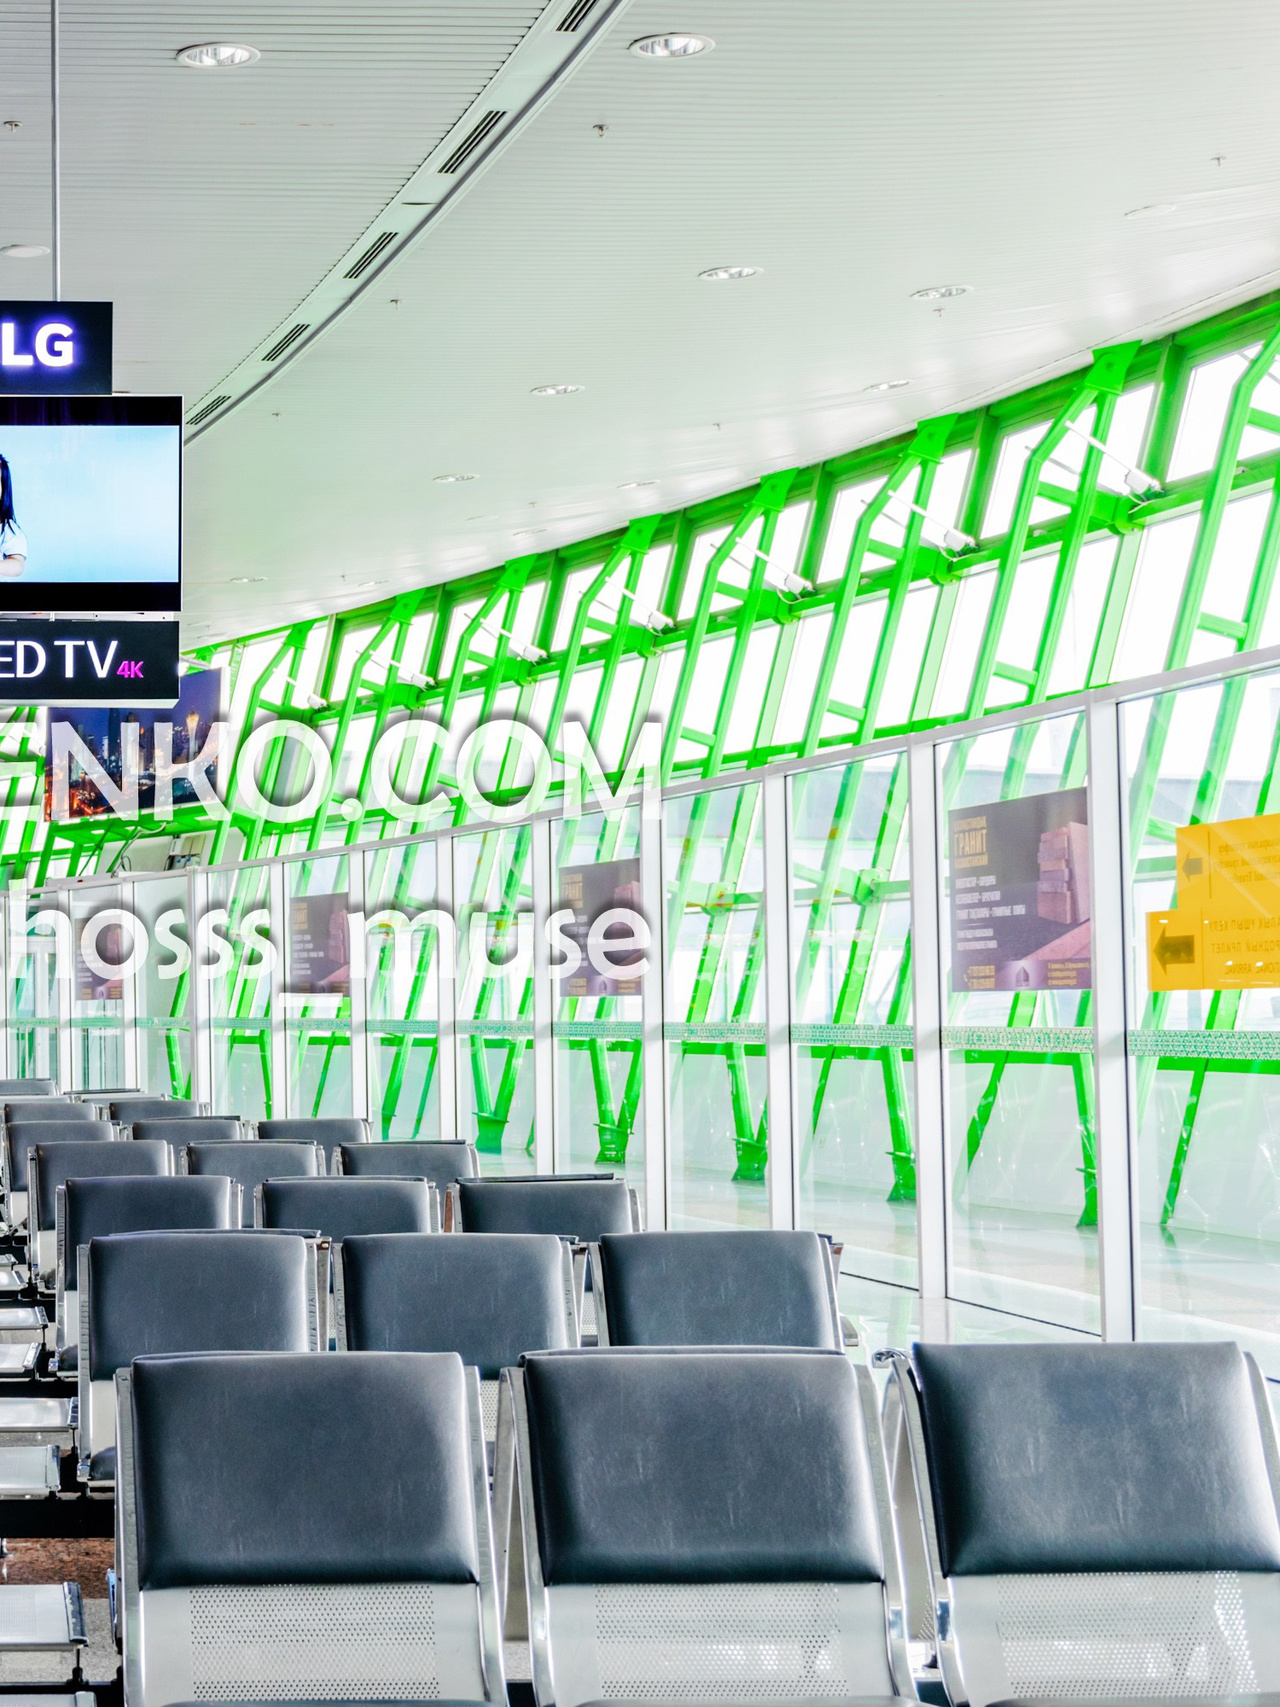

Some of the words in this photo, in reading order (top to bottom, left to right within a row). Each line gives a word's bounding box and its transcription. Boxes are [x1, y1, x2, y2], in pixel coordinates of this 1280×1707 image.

[1, 322, 74, 367] LG
[54, 640, 118, 679] TV
[116, 661, 144, 679] 4K
